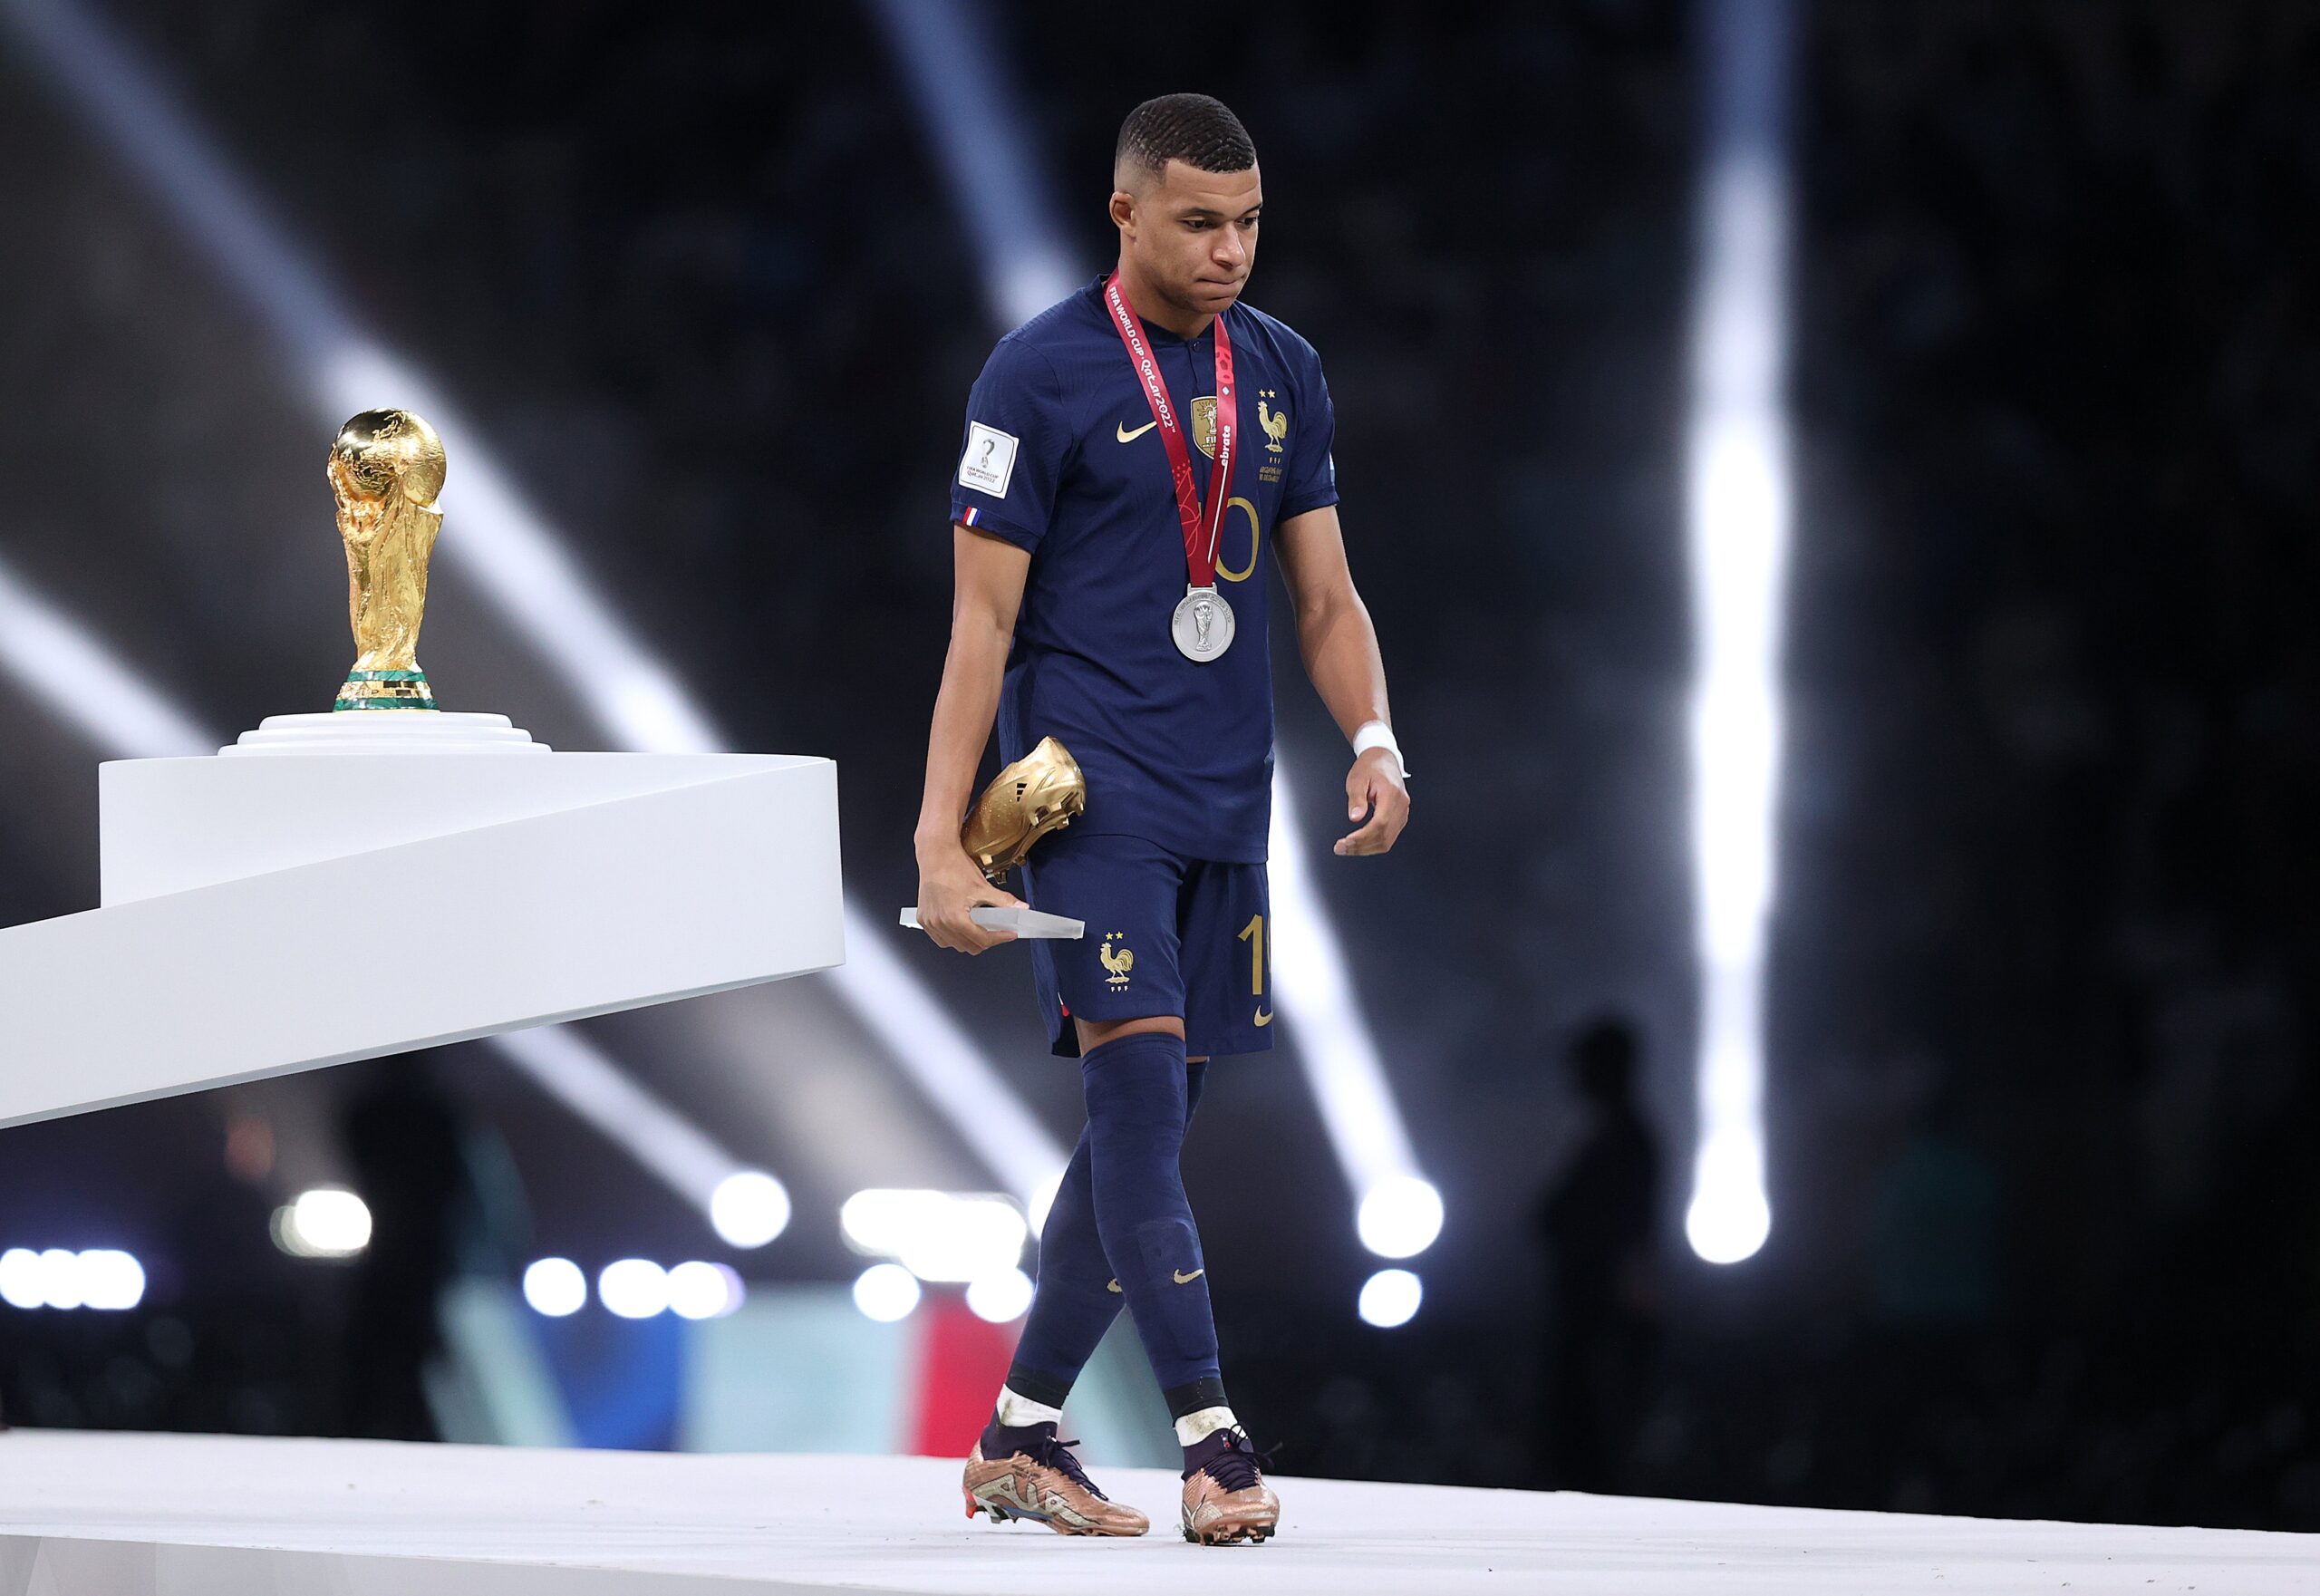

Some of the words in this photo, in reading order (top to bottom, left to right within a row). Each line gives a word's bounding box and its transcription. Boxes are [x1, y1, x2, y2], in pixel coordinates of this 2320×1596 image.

[1109, 286, 1120, 306] FIFA
[1116, 304, 1136, 337] WORLD
[1131, 338, 1144, 356] CUP
[1237, 914, 1271, 995] 1
